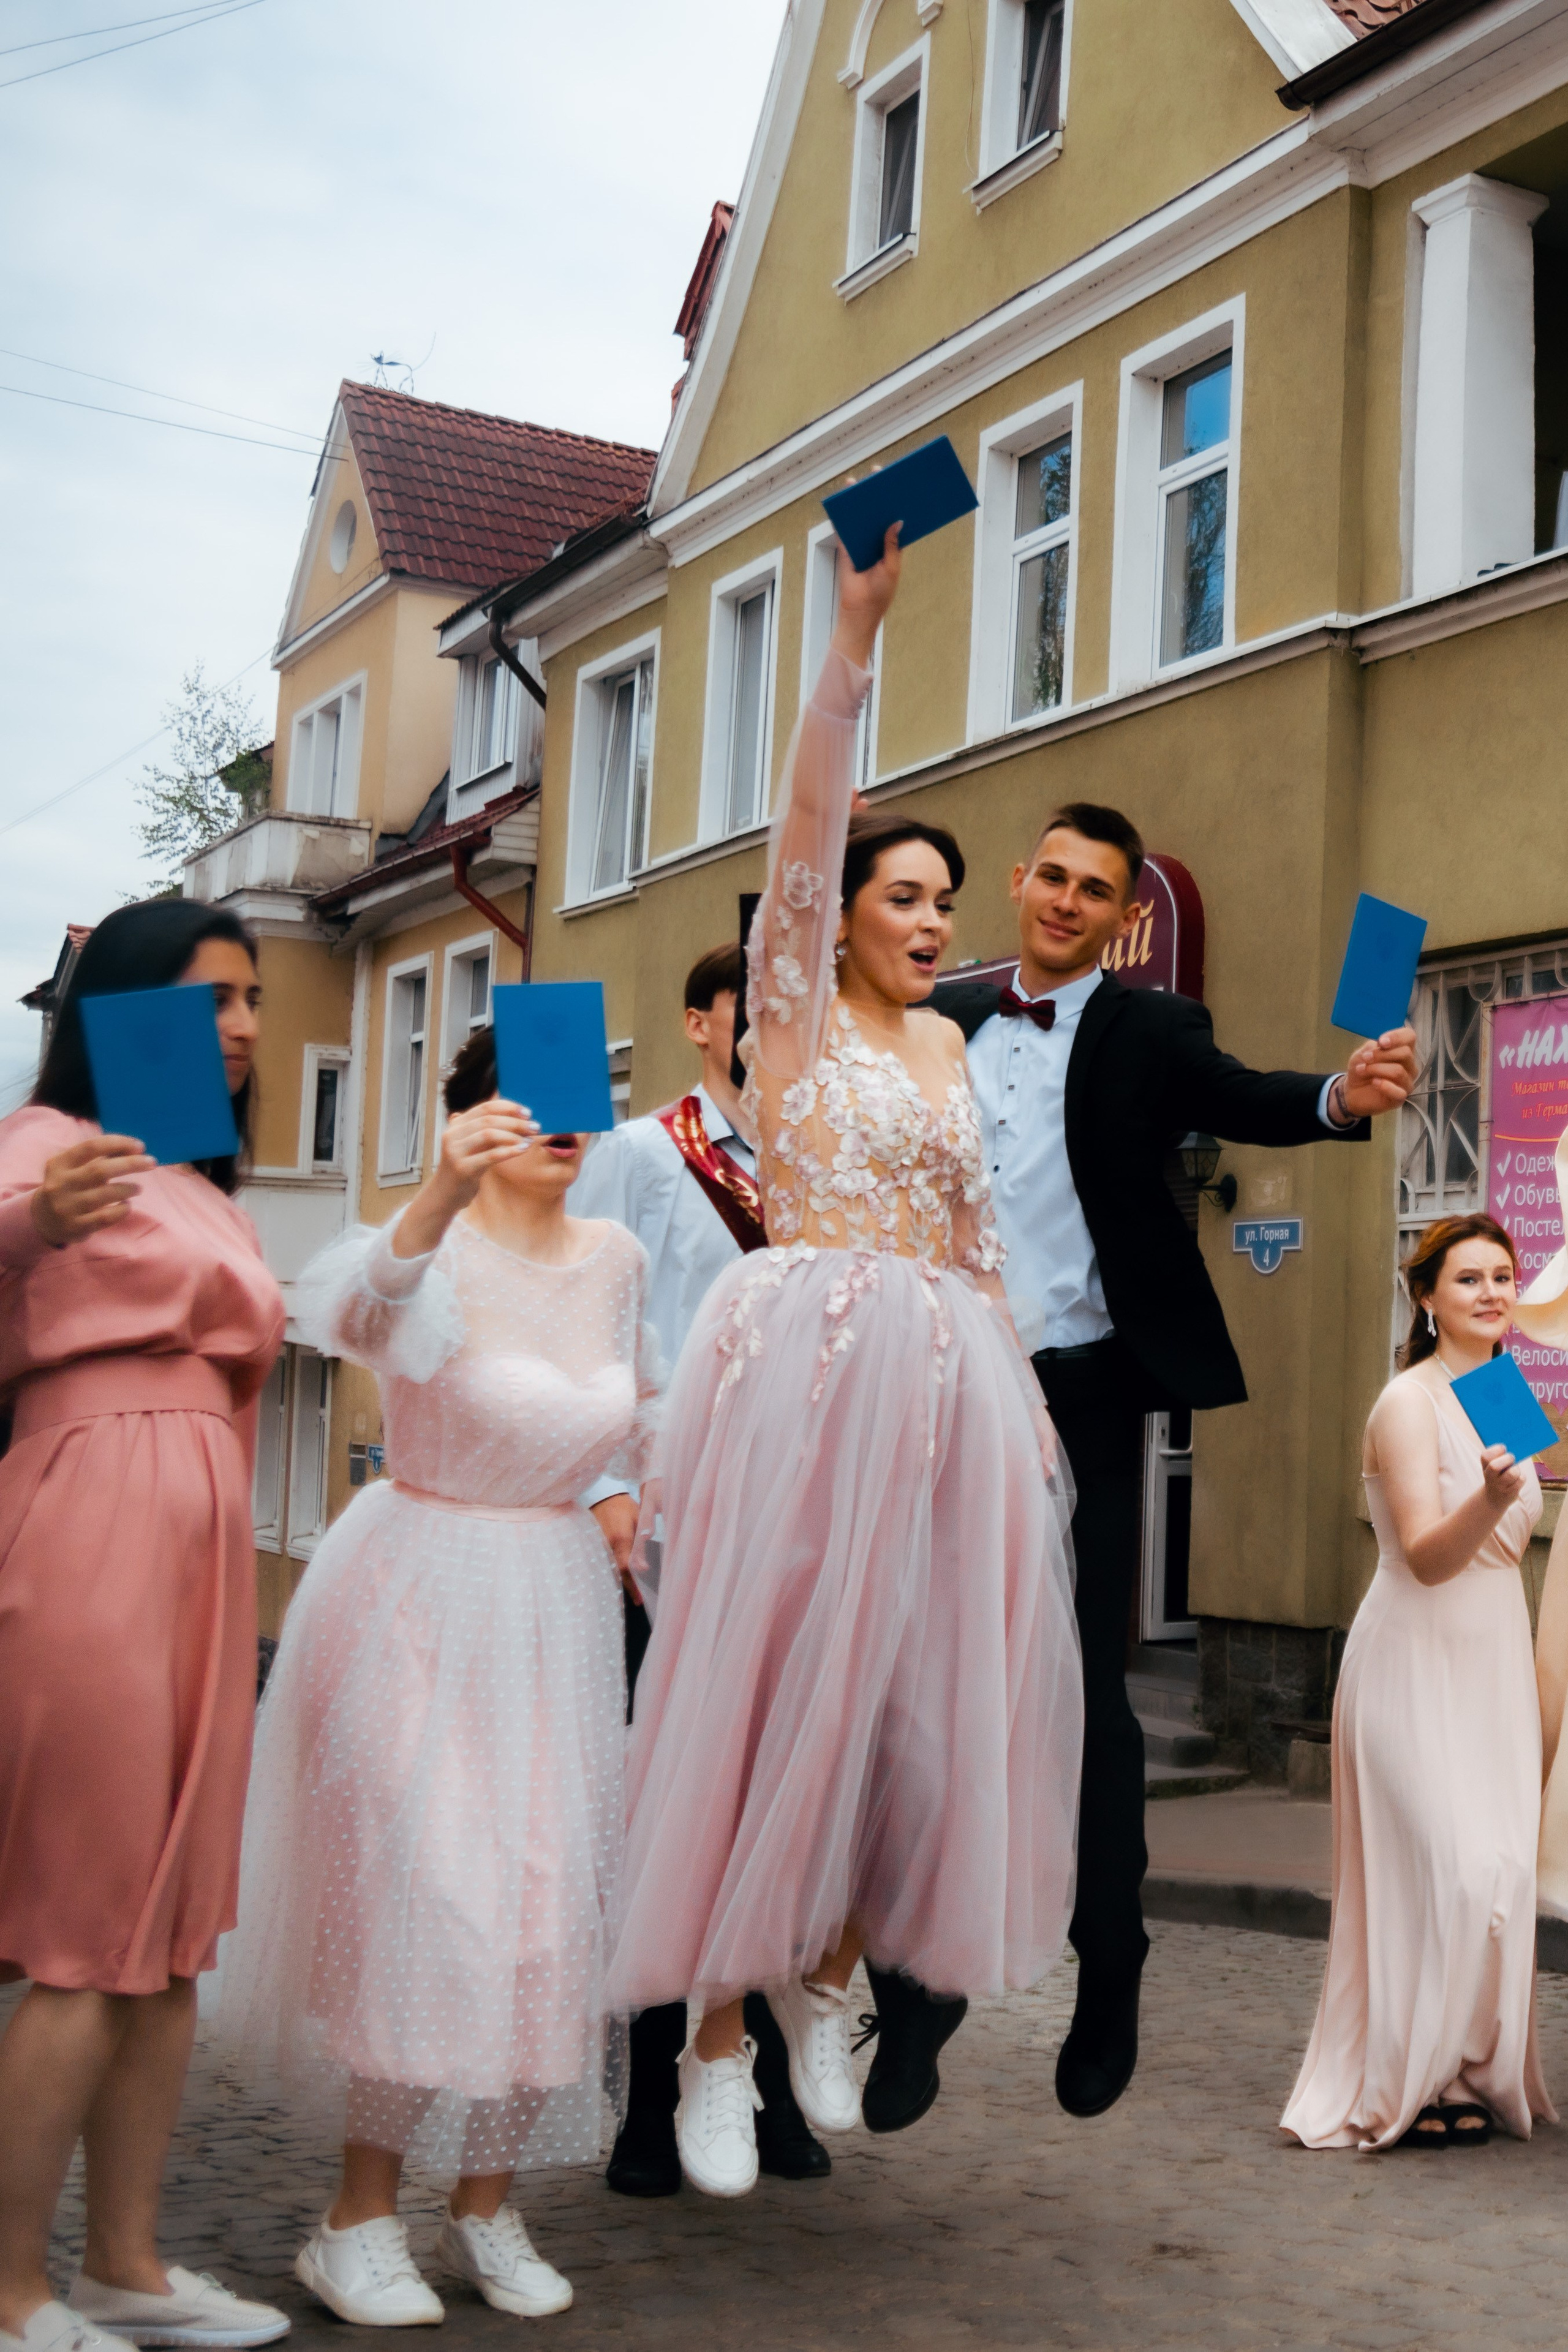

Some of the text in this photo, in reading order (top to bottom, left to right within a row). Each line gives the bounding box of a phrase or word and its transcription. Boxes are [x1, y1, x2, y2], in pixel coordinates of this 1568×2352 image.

[1511, 1080, 1555, 1096] Магазин
[1521, 1108, 1532, 1119] из
[1245, 1227, 1289, 1245] ул. Горная
[1263, 1248, 1270, 1267] 4
